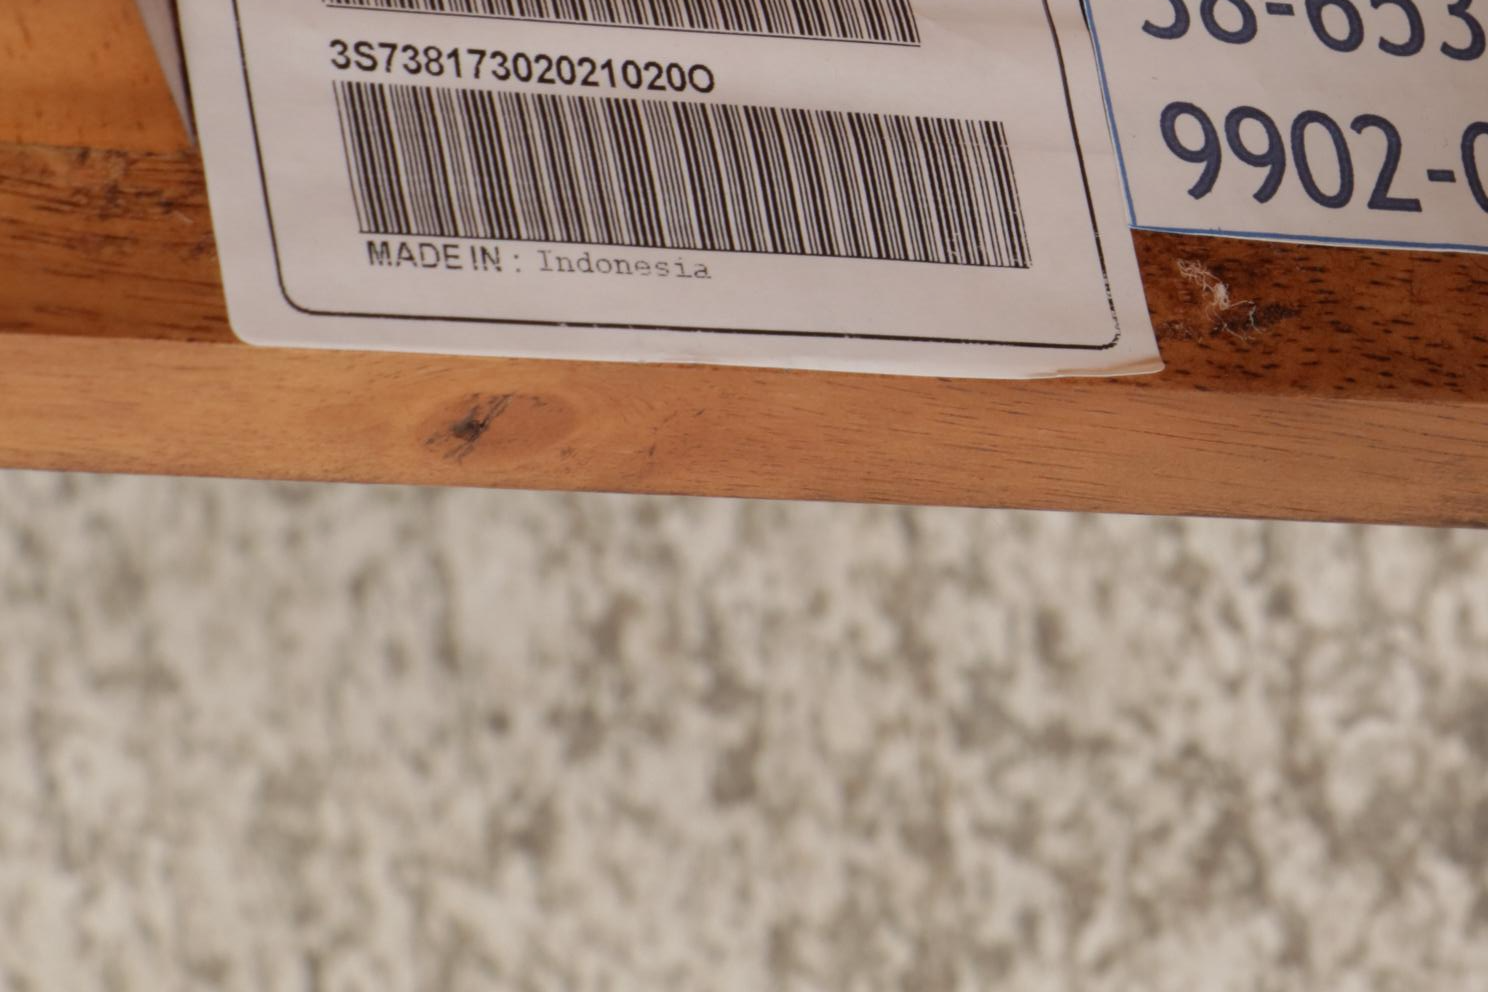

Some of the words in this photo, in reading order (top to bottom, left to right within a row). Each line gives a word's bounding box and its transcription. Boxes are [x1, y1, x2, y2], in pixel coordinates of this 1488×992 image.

[365, 239, 463, 271] MADE
[470, 245, 503, 273] IN
[536, 248, 713, 281] Indonesia
